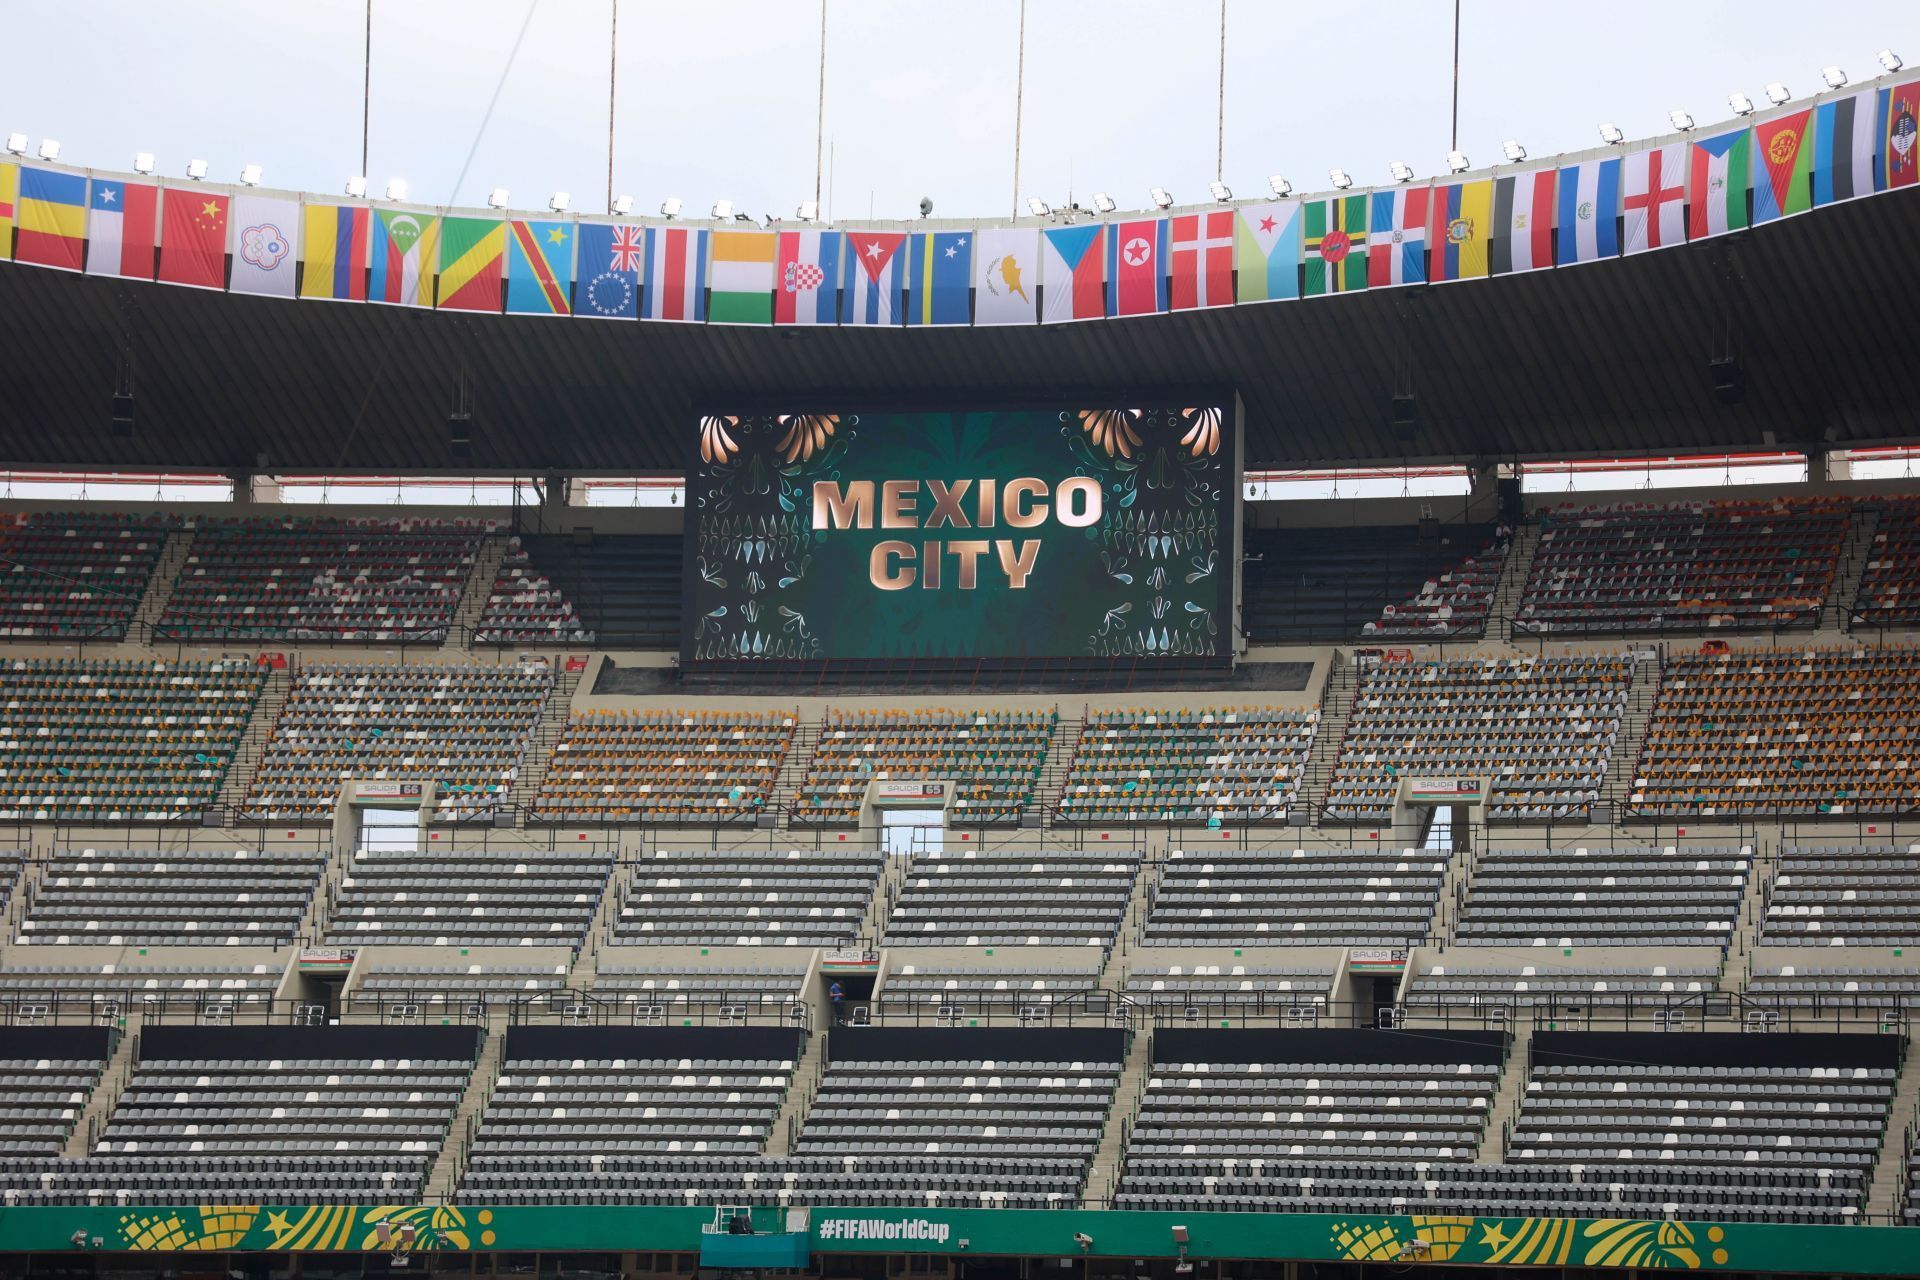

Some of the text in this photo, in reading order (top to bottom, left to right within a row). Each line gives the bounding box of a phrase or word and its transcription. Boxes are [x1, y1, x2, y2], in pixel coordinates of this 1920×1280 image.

[812, 476, 1102, 530] MEXICO
[869, 538, 1042, 591] CITY
[404, 785, 419, 794] 66
[926, 785, 941, 794] 65
[1461, 782, 1477, 791] 64
[863, 952, 879, 961] 23
[820, 1219, 949, 1243] #FIFAWorldCup
